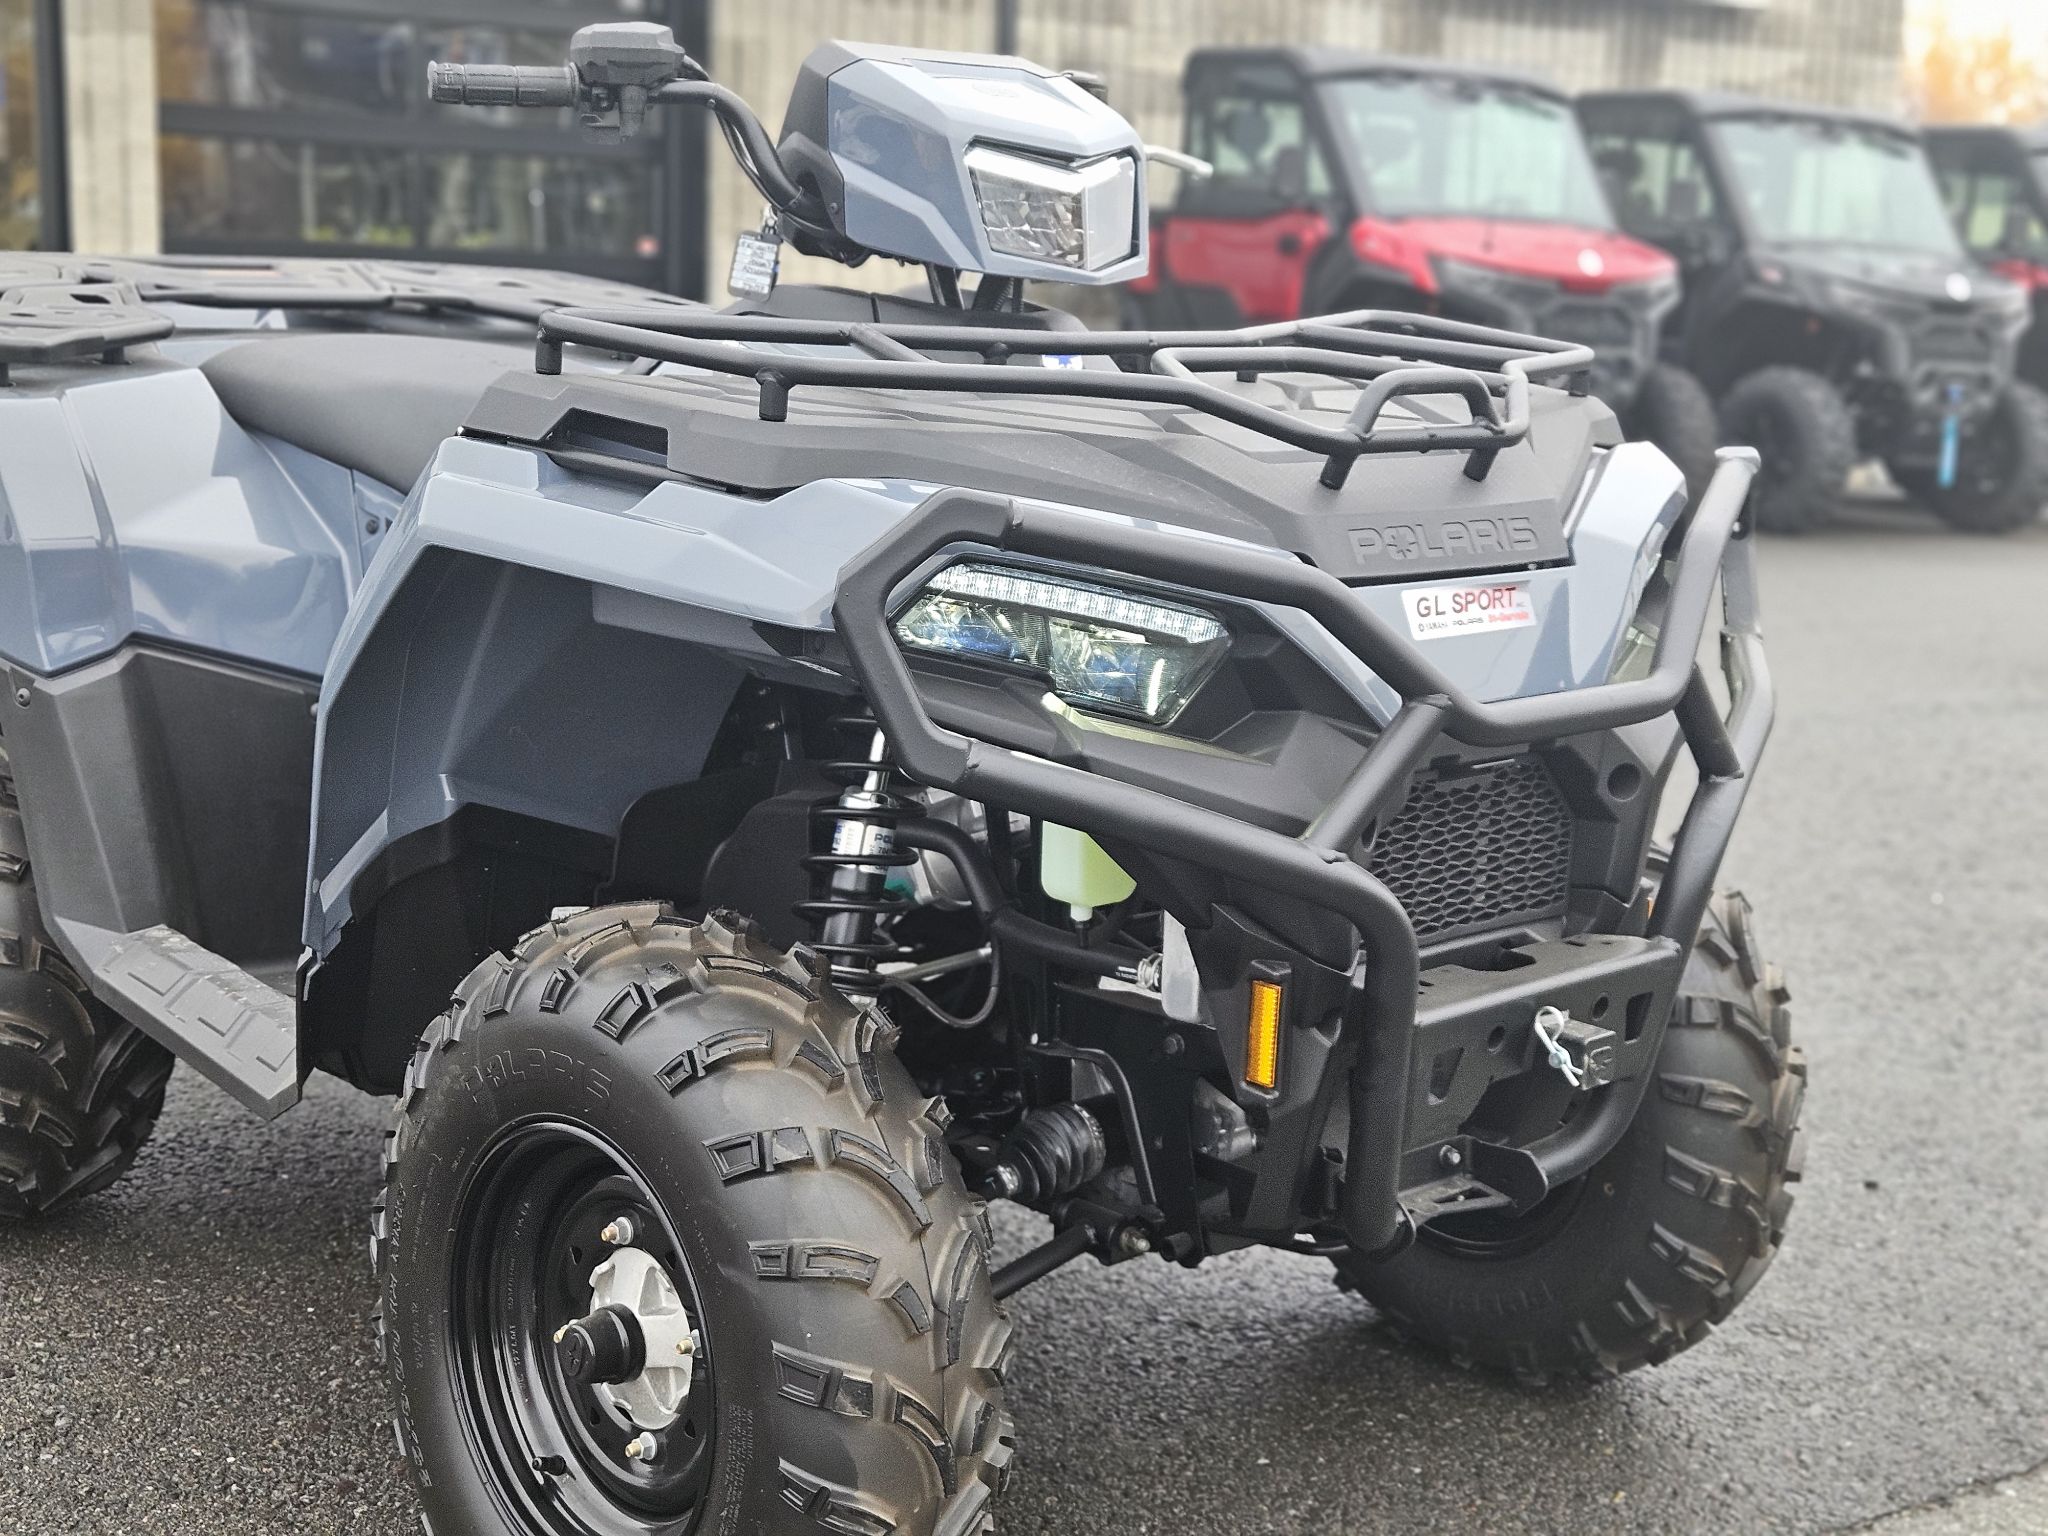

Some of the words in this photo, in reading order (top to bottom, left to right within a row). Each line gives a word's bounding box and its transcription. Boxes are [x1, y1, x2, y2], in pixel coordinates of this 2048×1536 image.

[1347, 516, 1539, 565] POLARIS
[1416, 595, 1446, 618] GL
[1452, 586, 1517, 614] SPORT
